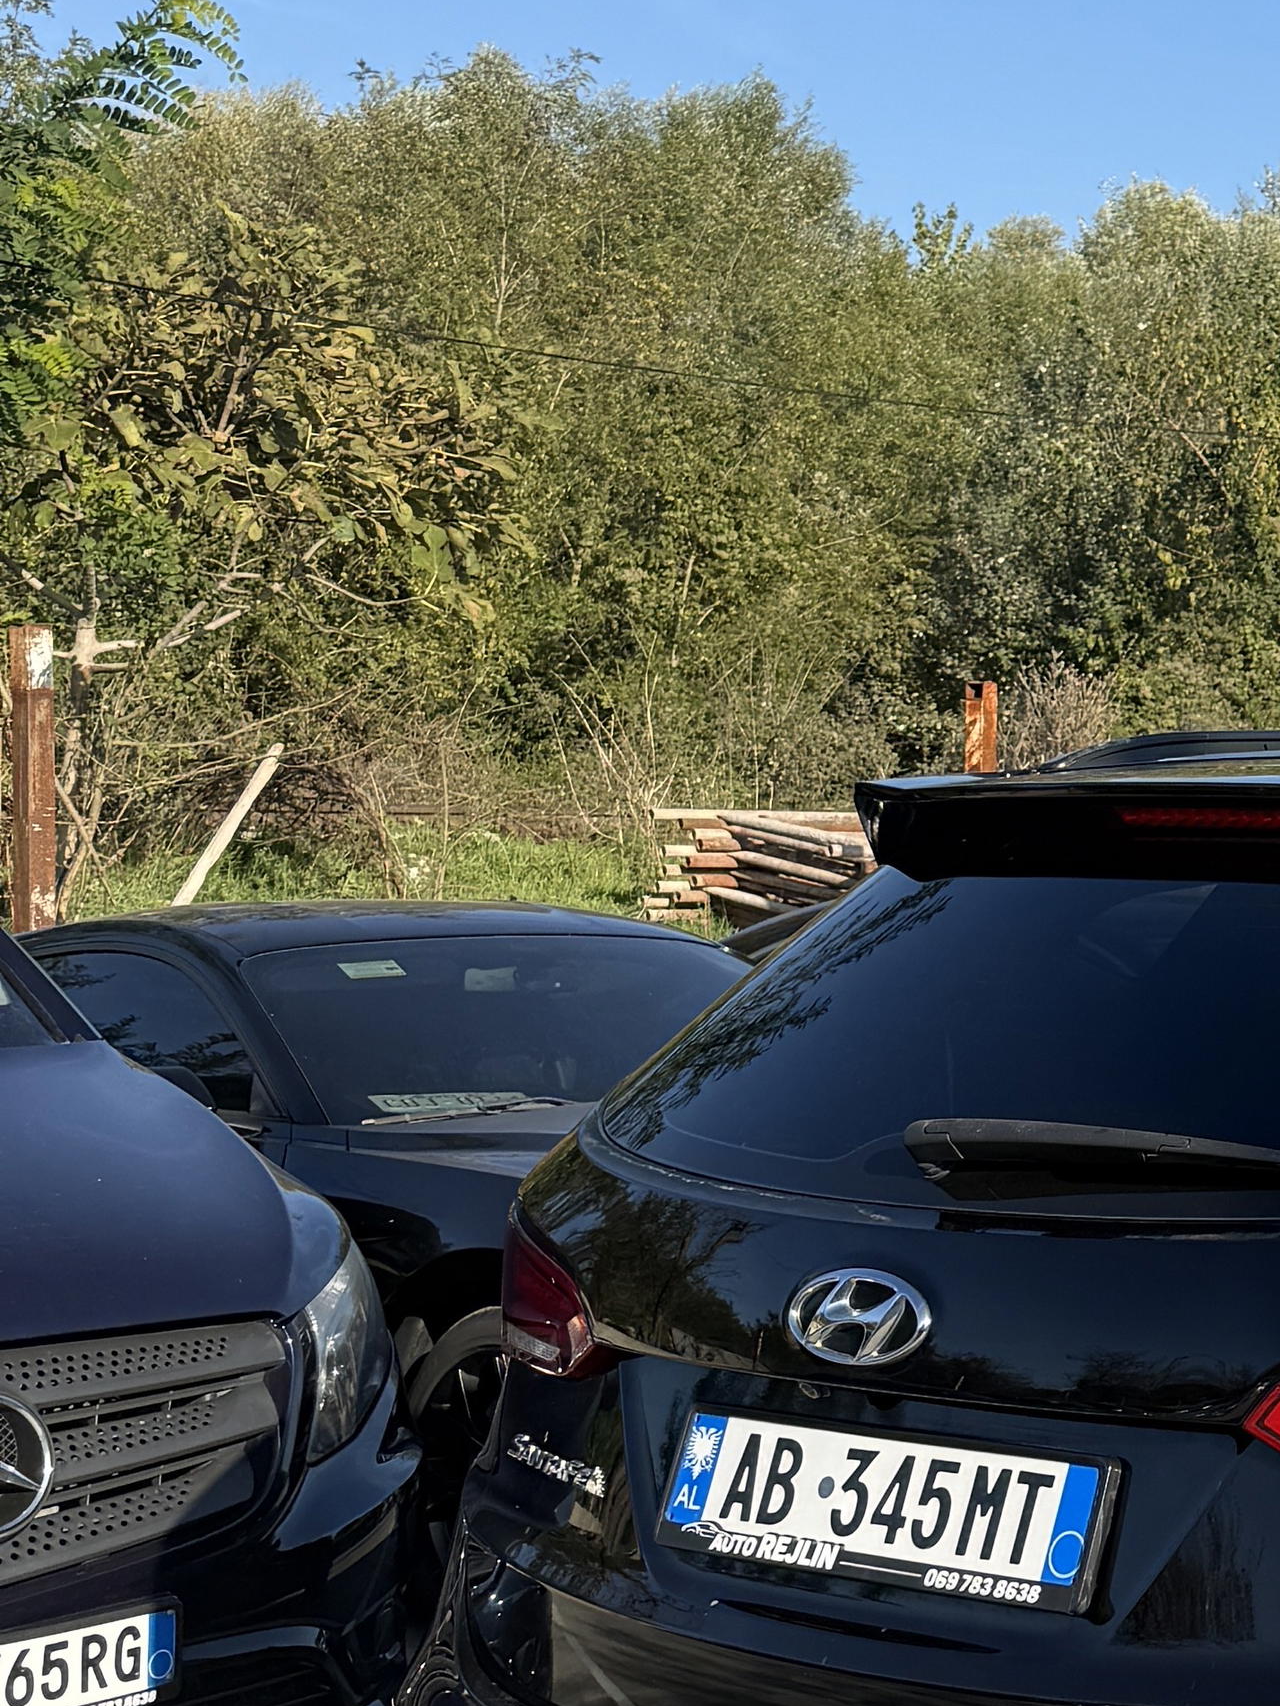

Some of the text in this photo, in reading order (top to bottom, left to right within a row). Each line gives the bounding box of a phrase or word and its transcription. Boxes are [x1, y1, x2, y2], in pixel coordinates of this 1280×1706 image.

[673, 1483, 700, 1511] AL
[719, 1433, 803, 1525] AB
[709, 1532, 840, 1571] AUTO REJLIN
